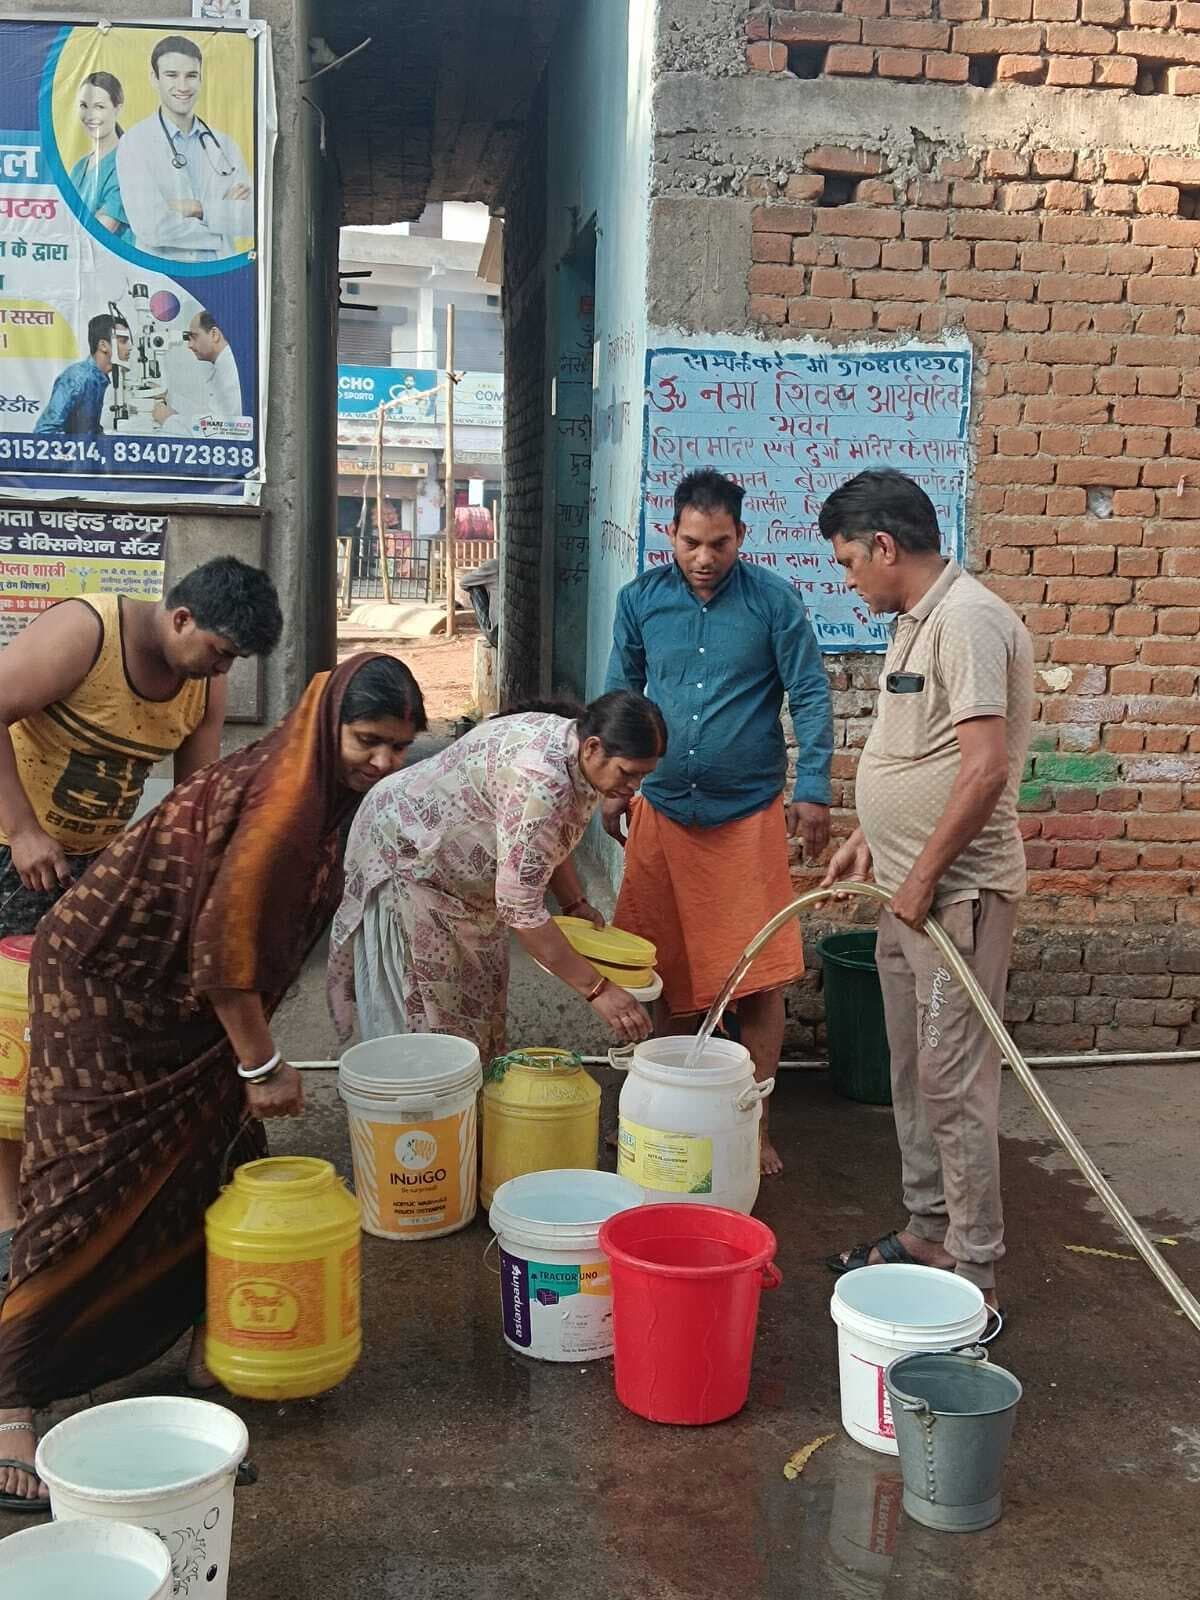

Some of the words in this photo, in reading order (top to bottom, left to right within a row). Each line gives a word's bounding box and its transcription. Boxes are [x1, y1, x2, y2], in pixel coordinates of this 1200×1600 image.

[338, 376, 375, 390] CHO
[113, 441, 254, 468] 8340723838
[540, 1271, 578, 1281] TRACTOR
[580, 1271, 598, 1281] UNO
[512, 1264, 523, 1338] asianpaints
